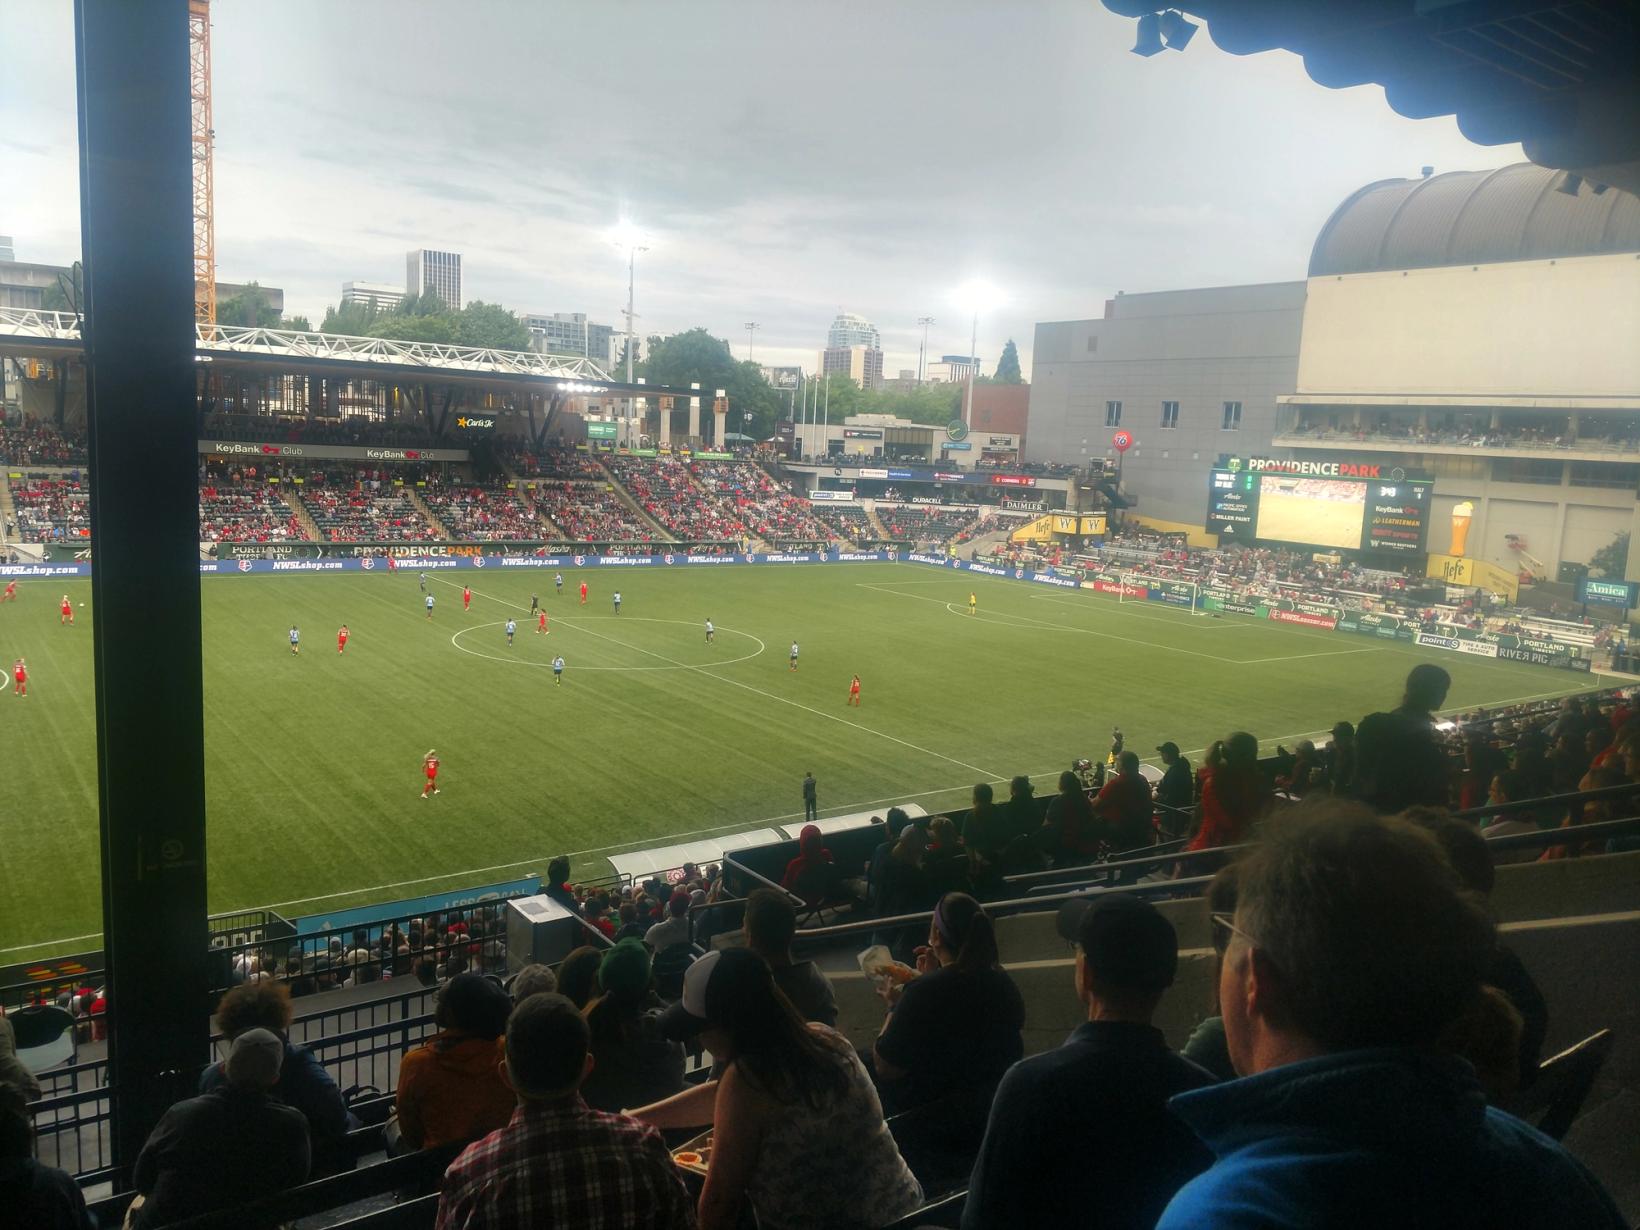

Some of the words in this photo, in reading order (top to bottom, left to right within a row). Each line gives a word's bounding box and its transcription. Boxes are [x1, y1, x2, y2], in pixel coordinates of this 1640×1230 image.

[1115, 434, 1127, 446] 76
[216, 443, 260, 455] KeyBank
[283, 446, 303, 456] Club
[367, 450, 405, 459] KeyBank
[913, 497, 942, 505] DURACELL
[1006, 502, 1043, 511] DAIMLER
[1376, 505, 1404, 514] KeyBank
[502, 558, 560, 568] NWSLshop.com
[600, 557, 652, 566] NWSLshop.com
[688, 555, 735, 564] NWSLshop.com
[767, 555, 810, 563] NWSLshop.com
[839, 554, 879, 562] NWSLshop.com
[273, 561, 343, 571] NWSLshop.com
[395, 559, 458, 569] NWSLshop.com
[969, 563, 1007, 575] NWSLshop.com
[0, 566, 78, 577] WSLshop.com
[1444, 559, 1464, 580] Hefe
[1033, 574, 1076, 588] NWSLshop.com
[1102, 585, 1125, 593] KeyBank
[1591, 583, 1625, 597] Amica
[1298, 604, 1329, 614] PORTLAND
[1421, 635, 1446, 647] point
[1524, 640, 1565, 652] PORTLAND
[1532, 652, 1548, 665] PIG
